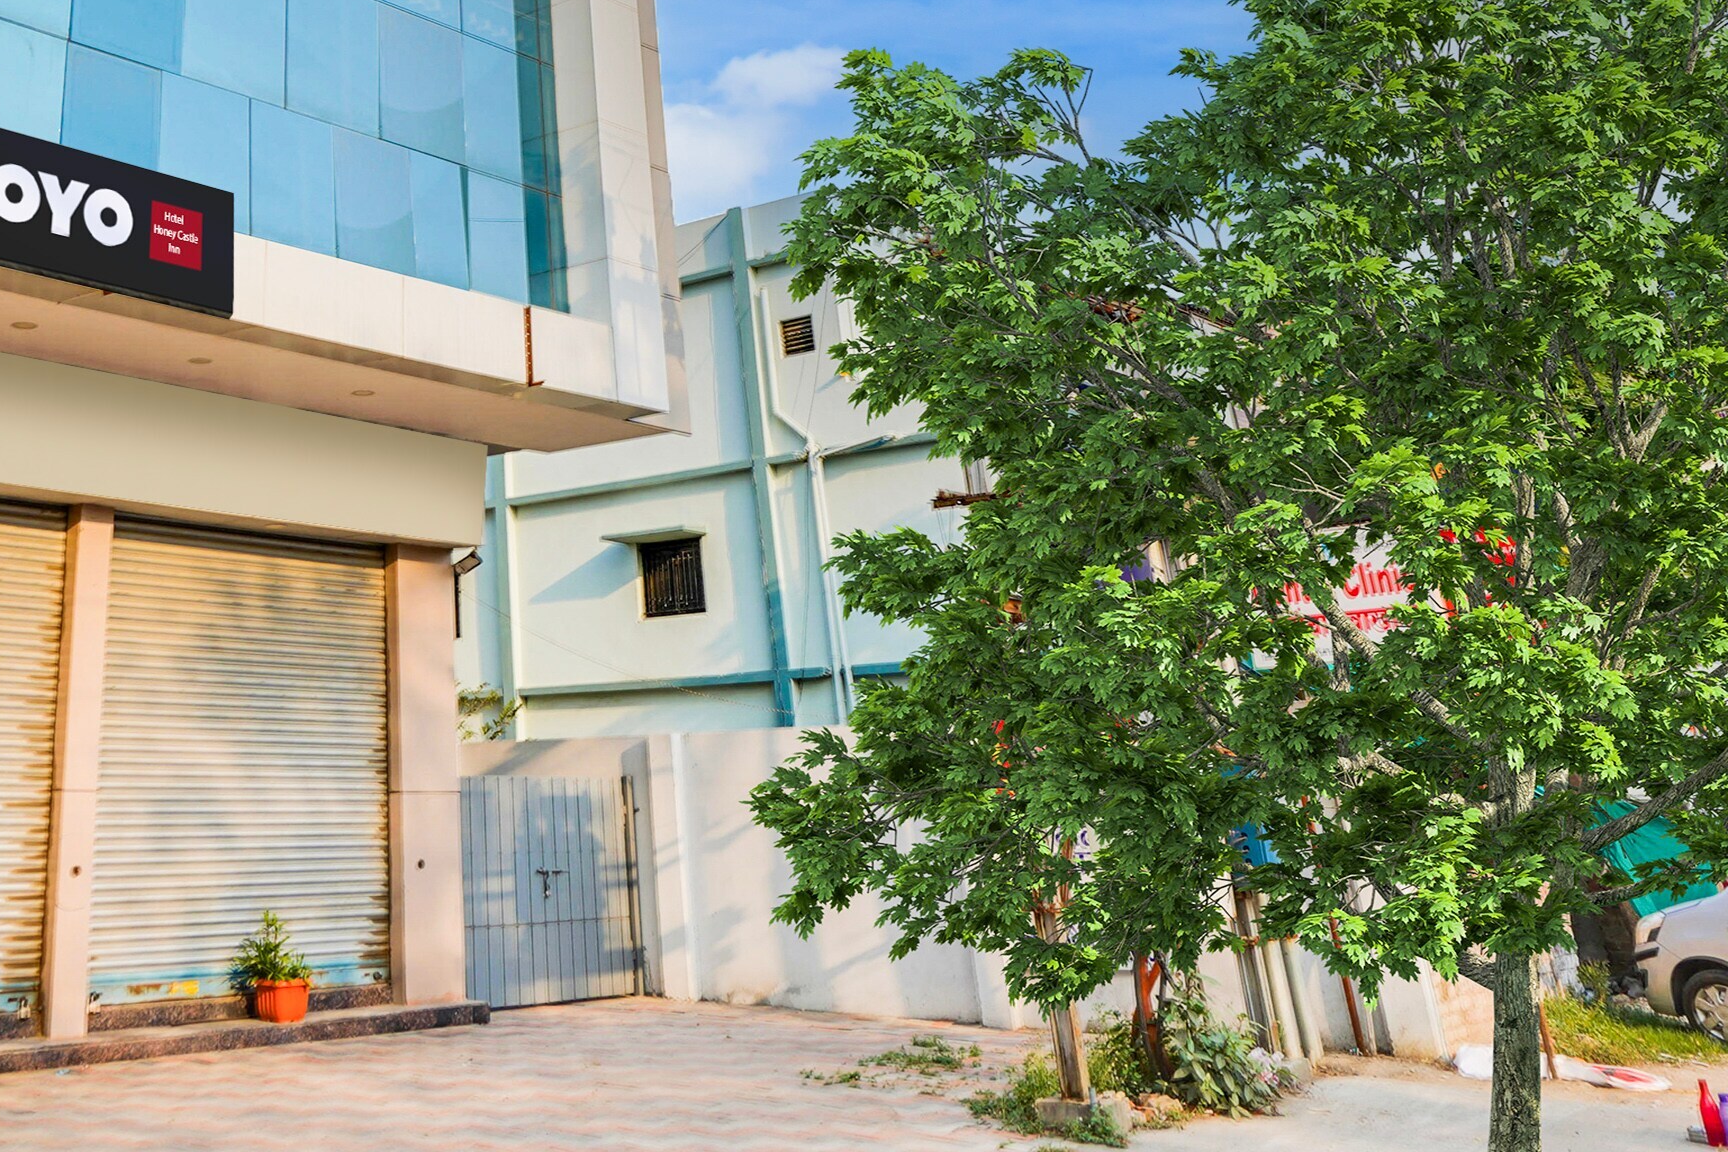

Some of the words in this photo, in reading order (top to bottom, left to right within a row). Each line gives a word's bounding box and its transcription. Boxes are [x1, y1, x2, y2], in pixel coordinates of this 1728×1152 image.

[164, 211, 185, 225] Hotel
[153, 224, 177, 240] Honey
[177, 230, 199, 244] Castle
[168, 242, 181, 255] Inn
